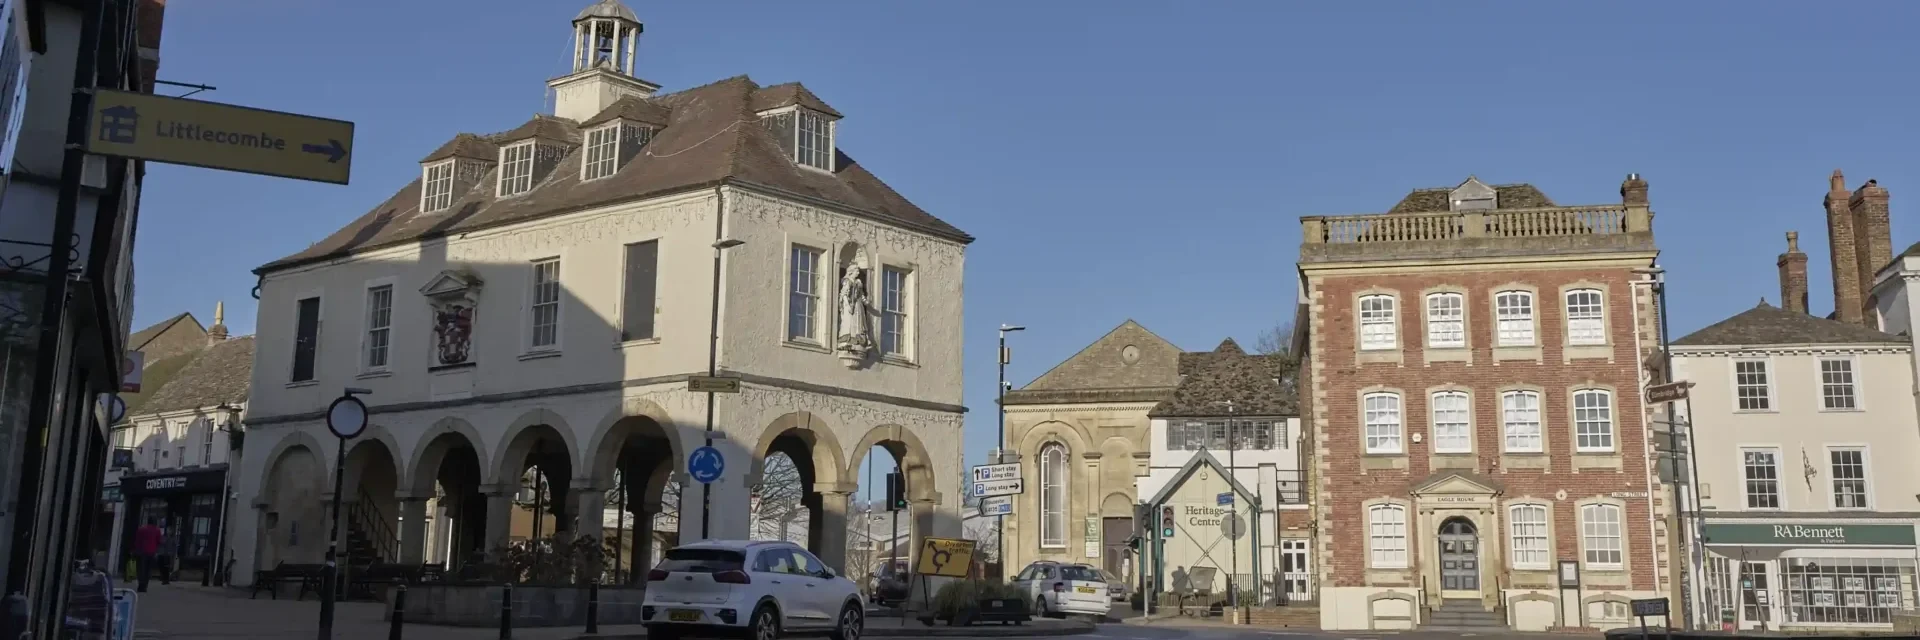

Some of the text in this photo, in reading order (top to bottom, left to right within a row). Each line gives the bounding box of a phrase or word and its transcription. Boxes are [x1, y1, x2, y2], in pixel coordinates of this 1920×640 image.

[156, 119, 286, 151] Littlecombe
[146, 478, 176, 489] COVENTRY
[1185, 505, 1224, 517] Heritage
[1189, 517, 1221, 526] Centre
